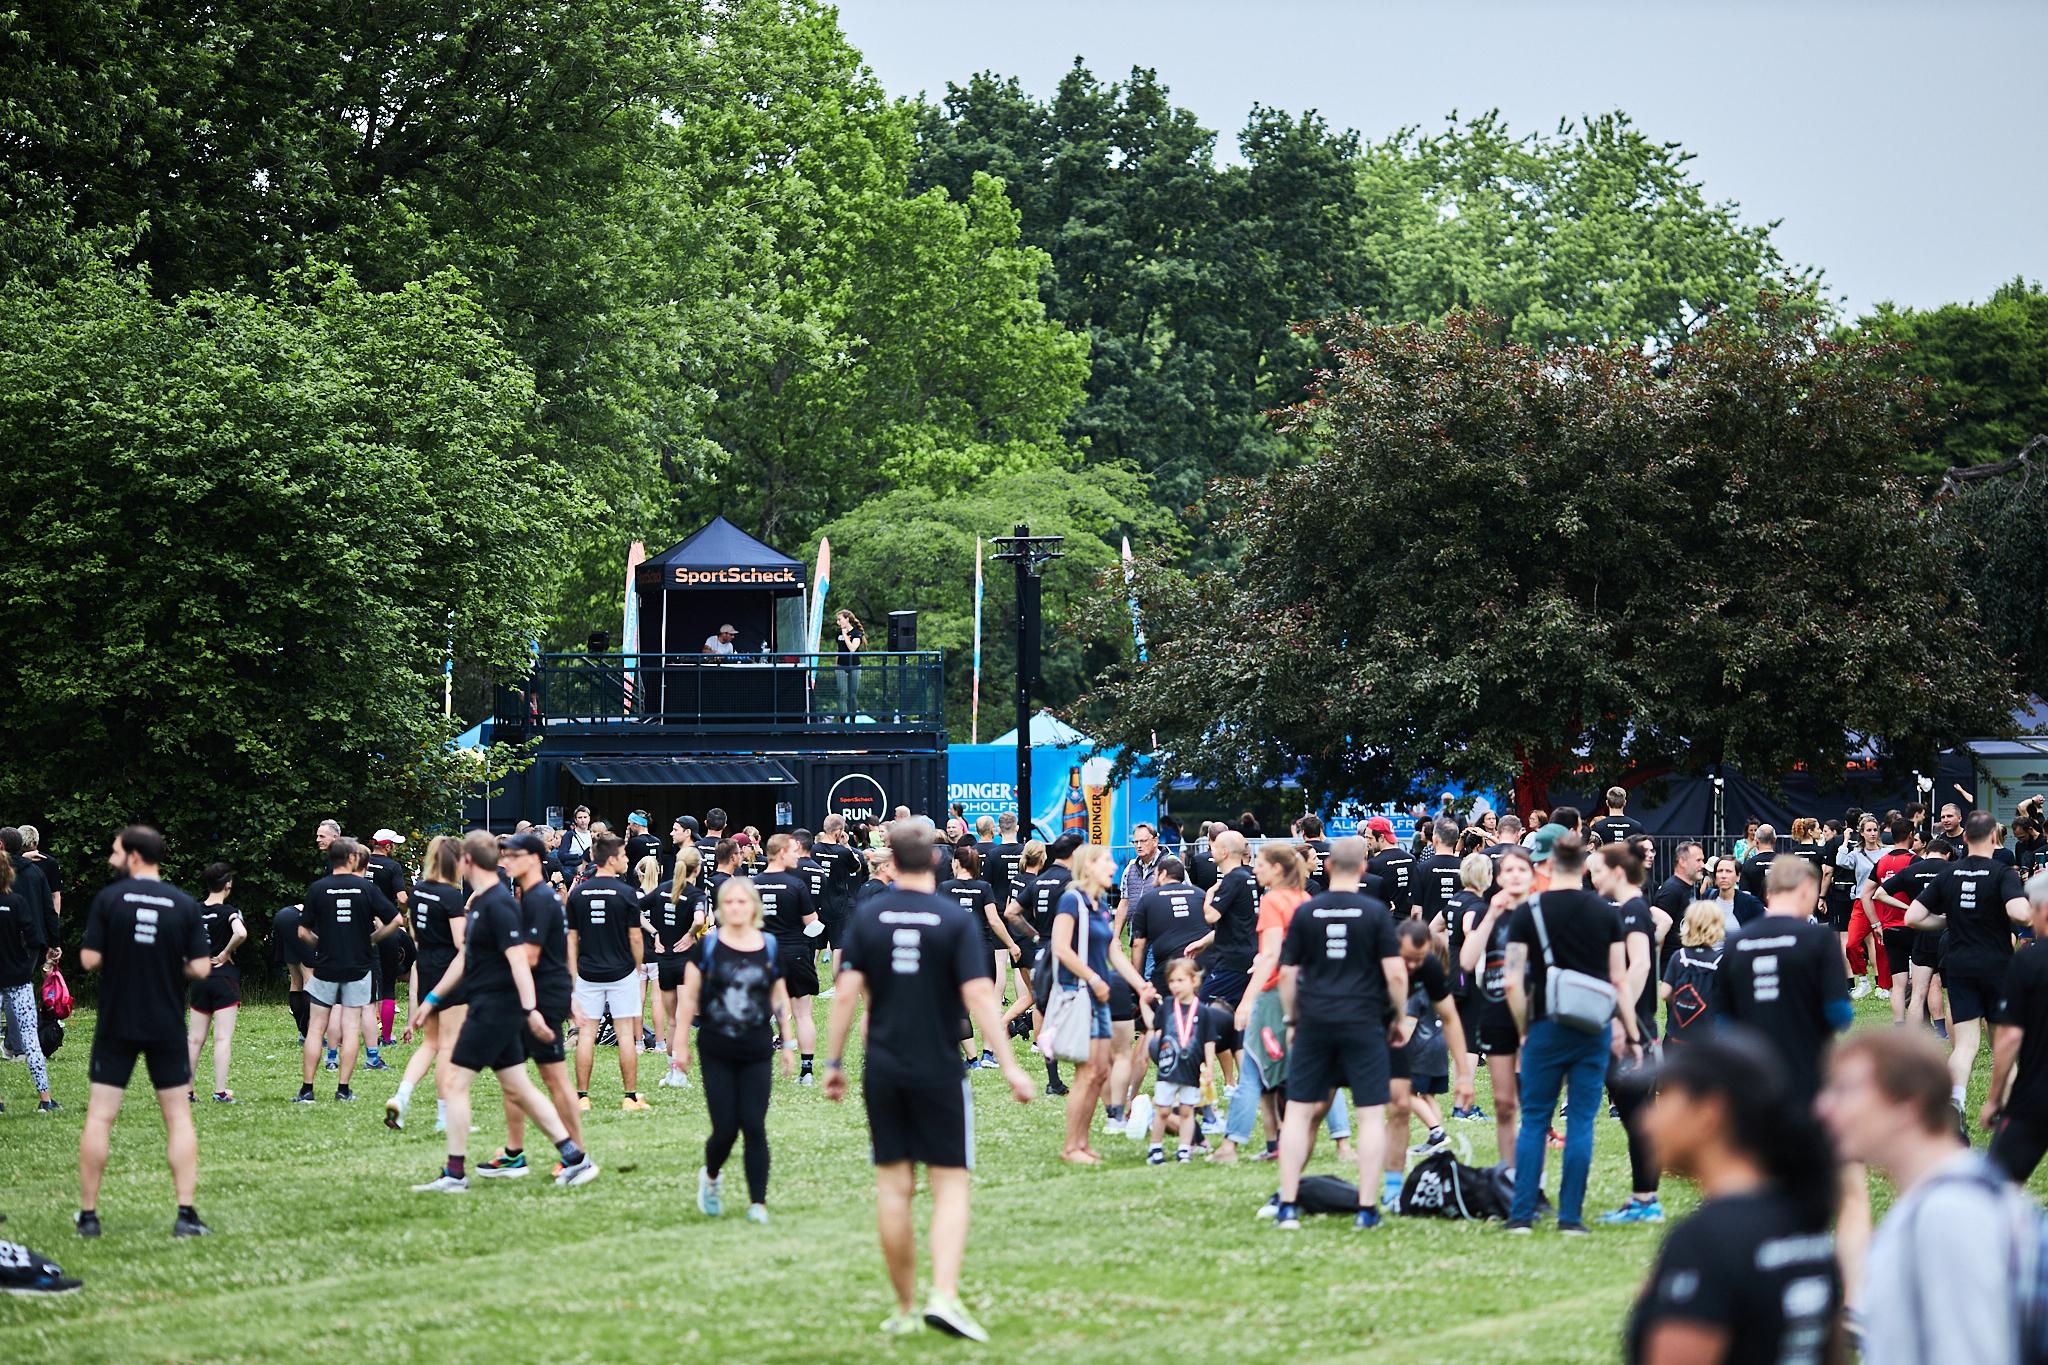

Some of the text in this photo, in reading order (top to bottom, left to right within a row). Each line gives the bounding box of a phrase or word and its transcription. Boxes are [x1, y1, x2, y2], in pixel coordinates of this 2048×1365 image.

[675, 567, 796, 586] SportScheck
[842, 807, 871, 822] RUN
[949, 801, 1018, 812] OHOLFR
[1091, 793, 1103, 846] ERDINGER
